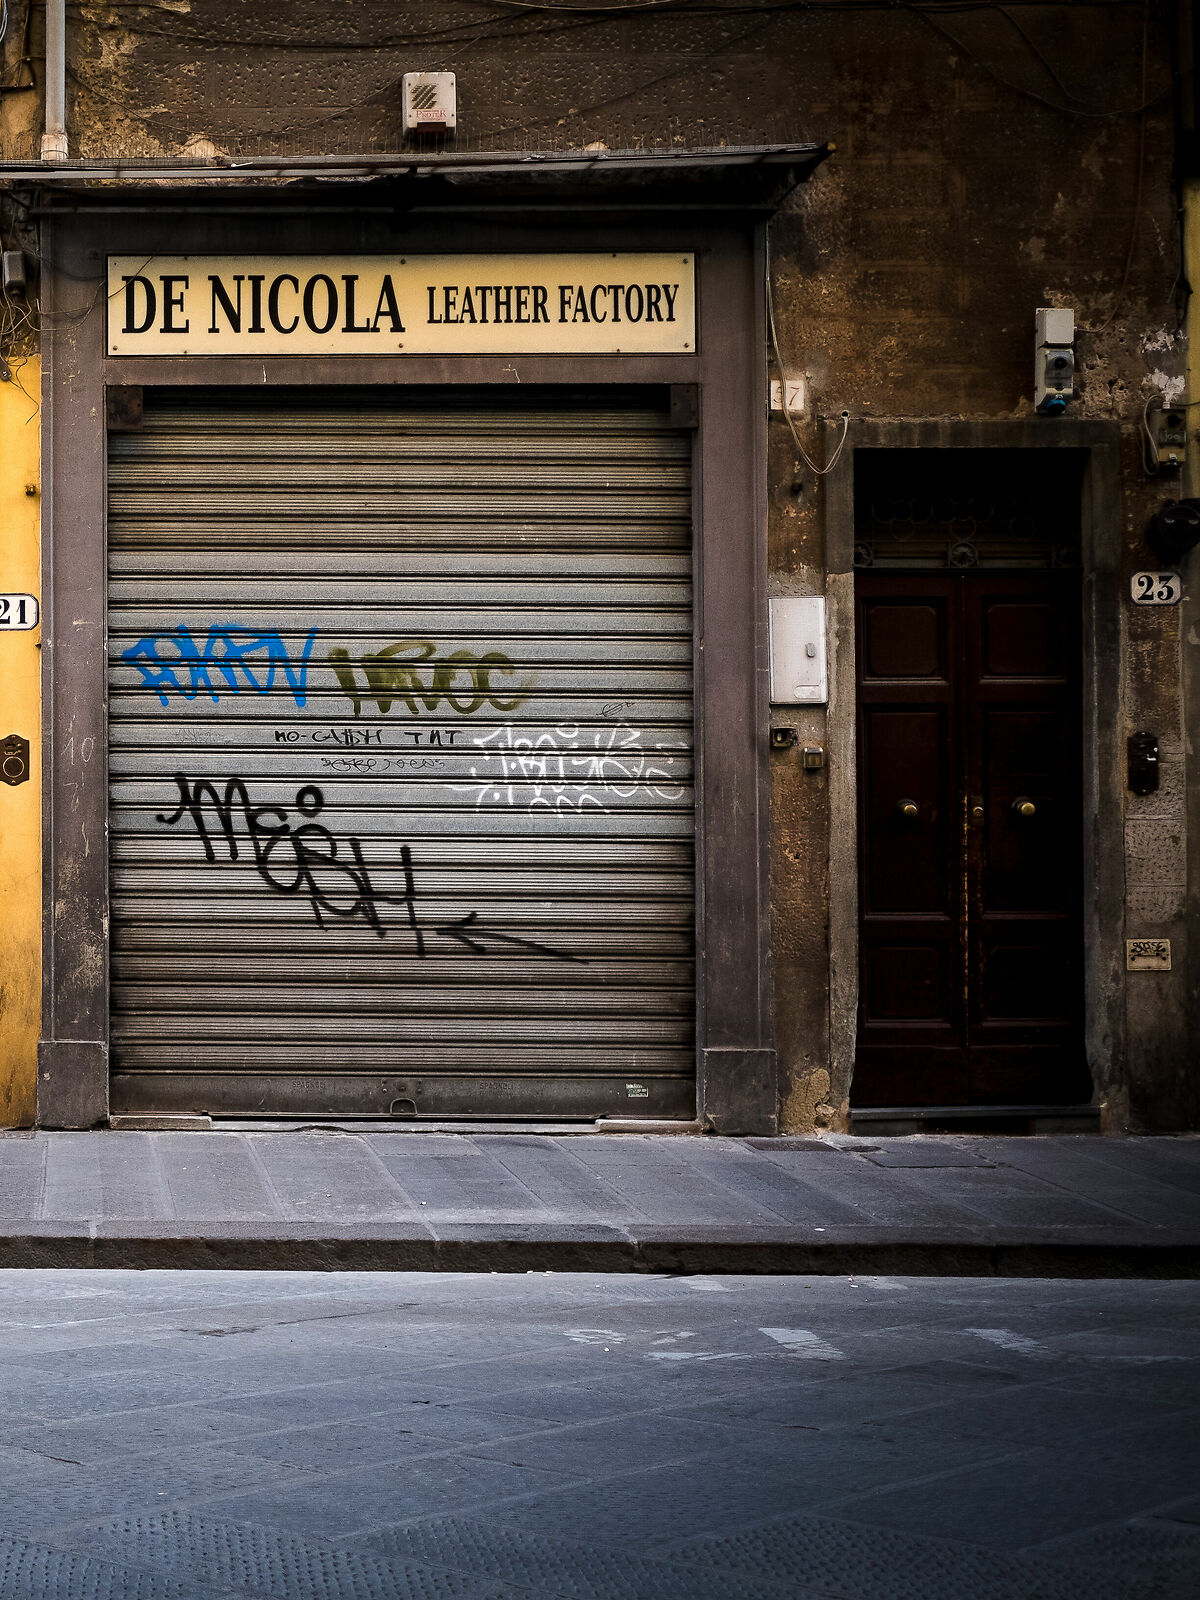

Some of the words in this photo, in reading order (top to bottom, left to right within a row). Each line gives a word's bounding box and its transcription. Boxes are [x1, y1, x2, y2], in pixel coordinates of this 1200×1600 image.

[121, 275, 190, 334] DE
[208, 274, 406, 335] NICOLA
[427, 285, 550, 324] LEATHER
[558, 283, 680, 323] FACTORY
[1137, 575, 1175, 601] 23
